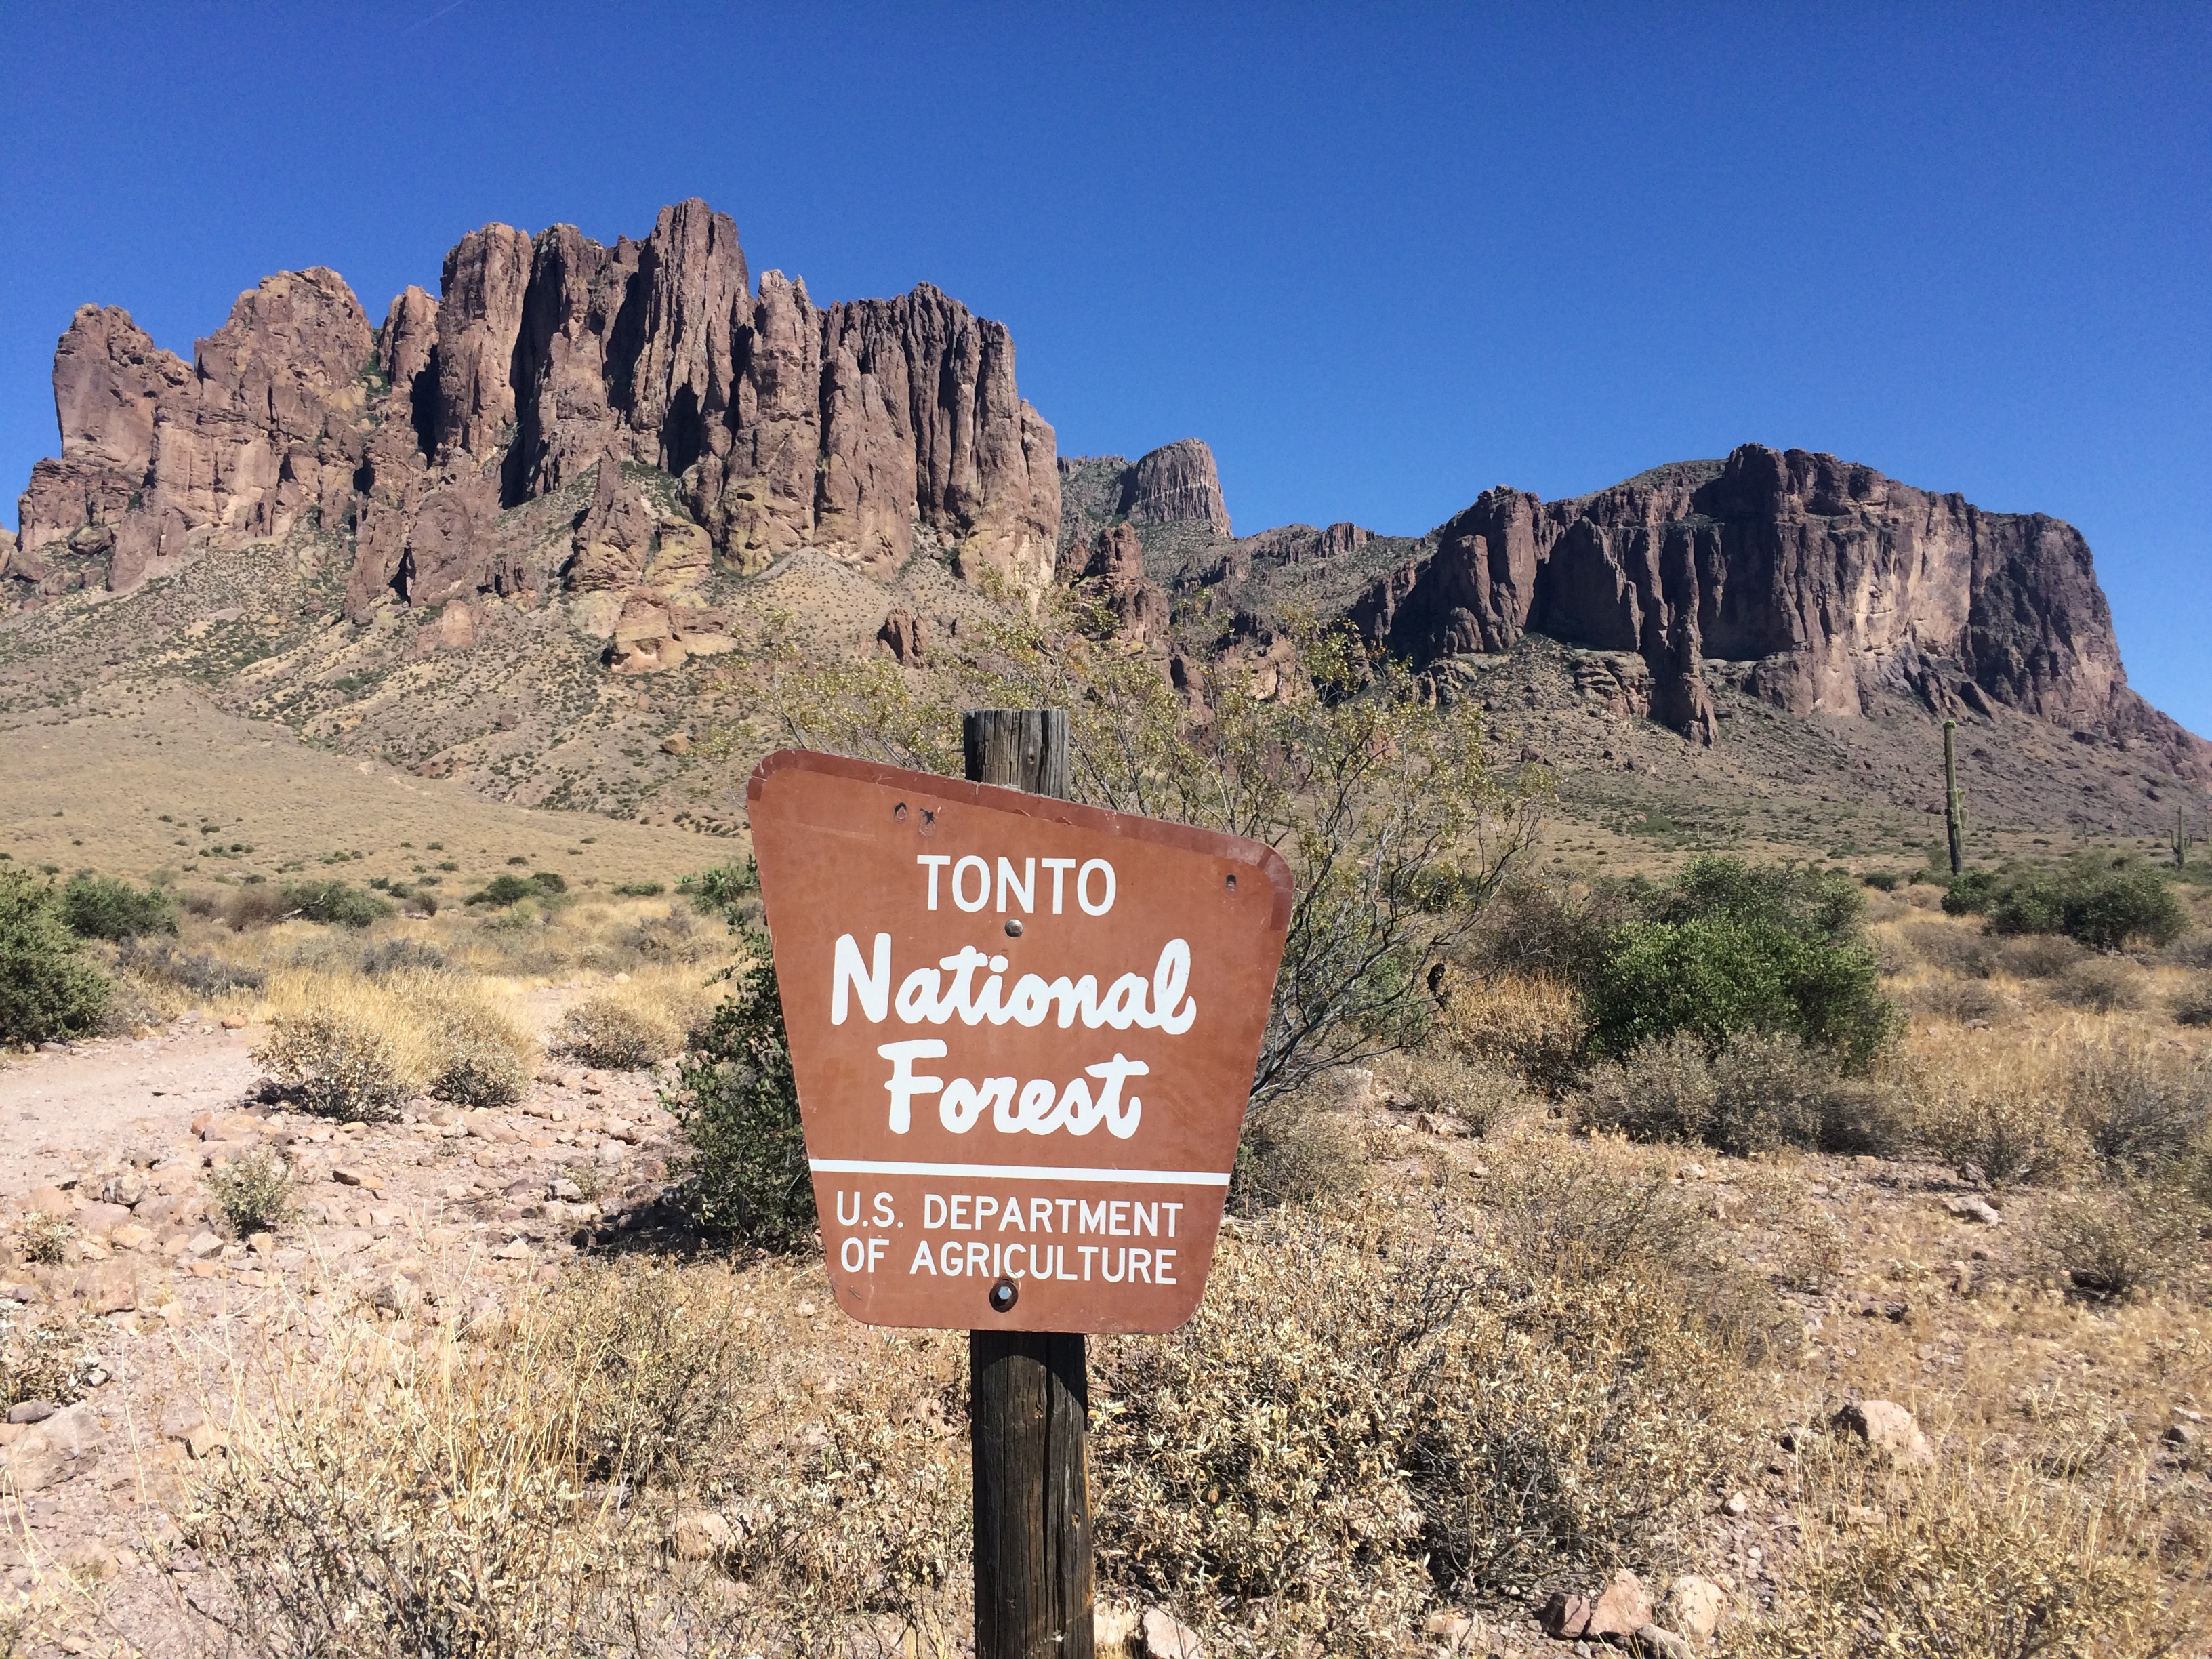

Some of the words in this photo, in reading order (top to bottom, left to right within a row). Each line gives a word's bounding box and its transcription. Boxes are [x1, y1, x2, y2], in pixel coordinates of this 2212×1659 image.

[916, 854, 1117, 917] TONTO
[830, 932, 1197, 1036] National
[876, 1038, 1150, 1140] Forest
[836, 1190, 903, 1228] U.S.
[923, 1193, 1184, 1238] DEPARTMENT
[840, 1236, 890, 1273] OF
[909, 1240, 1178, 1285] AGRICULTURE
